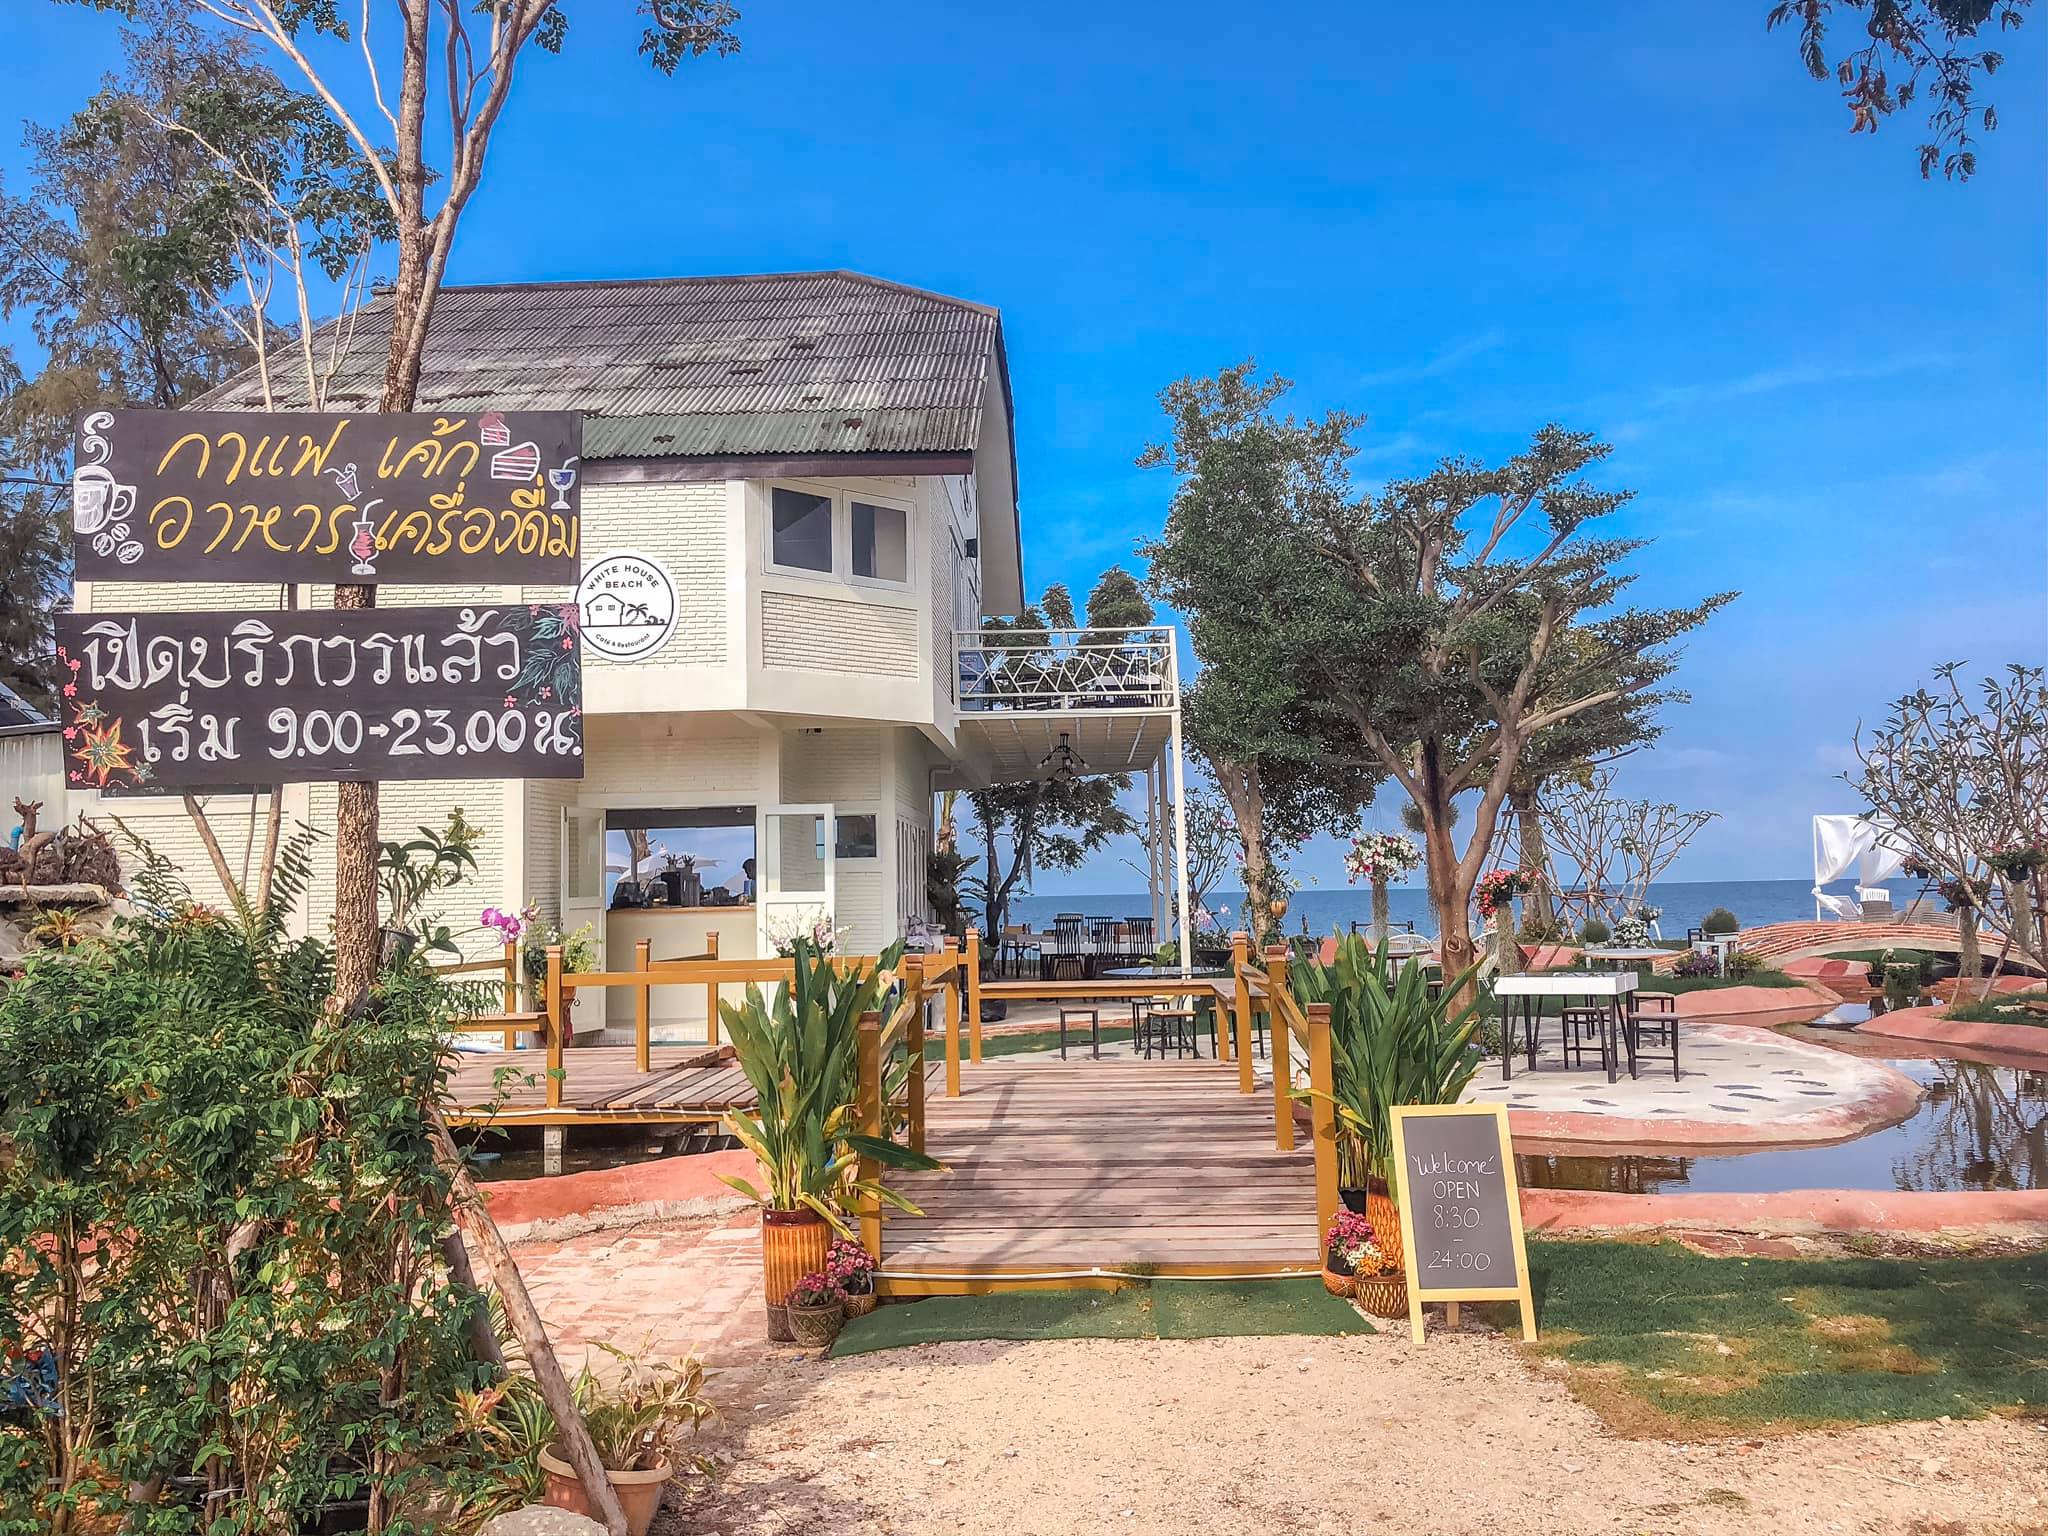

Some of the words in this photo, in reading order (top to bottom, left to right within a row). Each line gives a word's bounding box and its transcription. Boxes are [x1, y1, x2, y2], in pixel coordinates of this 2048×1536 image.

[156, 419, 352, 485] กาแฟ
[377, 417, 481, 479] เค้ก
[149, 496, 357, 554] อาหาร
[374, 473, 579, 559] เครื่องดื่ม
[587, 565, 619, 591] WHITE
[624, 565, 659, 588] HOUSE
[605, 580, 643, 589] BEACH
[81, 608, 521, 691] เปิดบริการแล้ว
[136, 687, 241, 763] เริ่ม
[1433, 1180, 1480, 1199] OPEN
[1433, 1204, 1480, 1229] 8:30
[1427, 1250, 1491, 1271] 24:00
